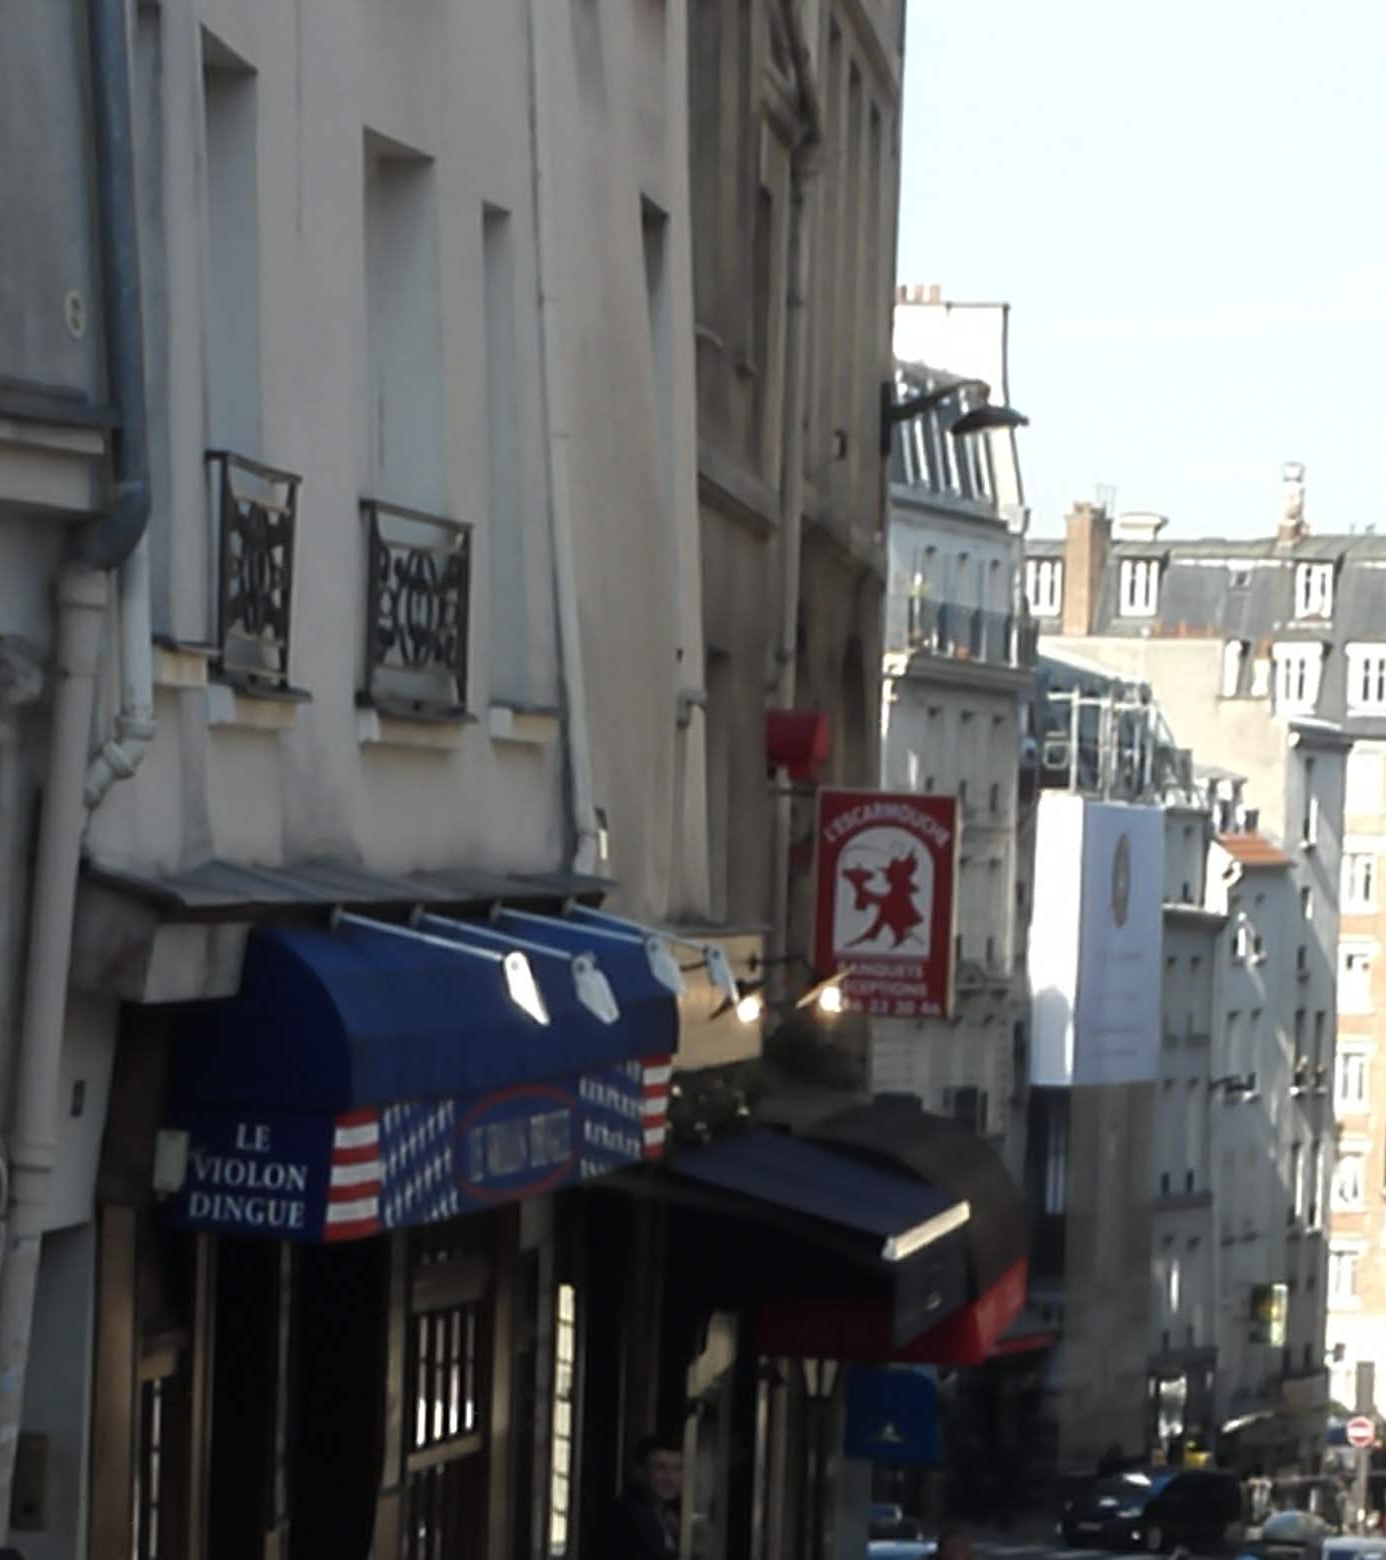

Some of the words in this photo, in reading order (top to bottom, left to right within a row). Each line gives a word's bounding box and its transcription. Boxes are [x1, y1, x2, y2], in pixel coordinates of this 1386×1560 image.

[236, 1122, 271, 1152] LE
[192, 1150, 309, 1192] VIOLON
[189, 1191, 306, 1229] DINGUE
